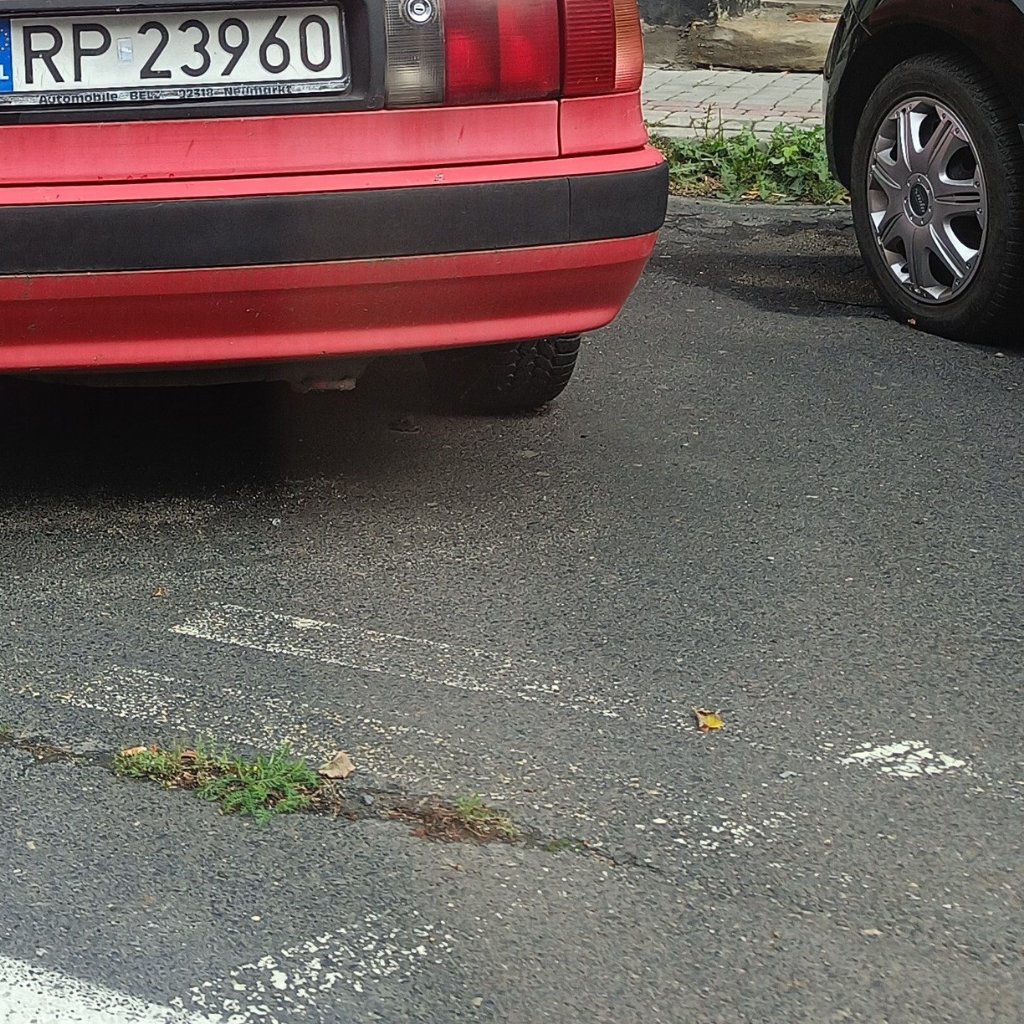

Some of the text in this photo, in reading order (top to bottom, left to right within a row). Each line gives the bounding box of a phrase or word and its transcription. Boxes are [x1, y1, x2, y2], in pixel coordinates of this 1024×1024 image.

[22, 14, 331, 84] RP 23960
[38, 93, 118, 105] Automobile
